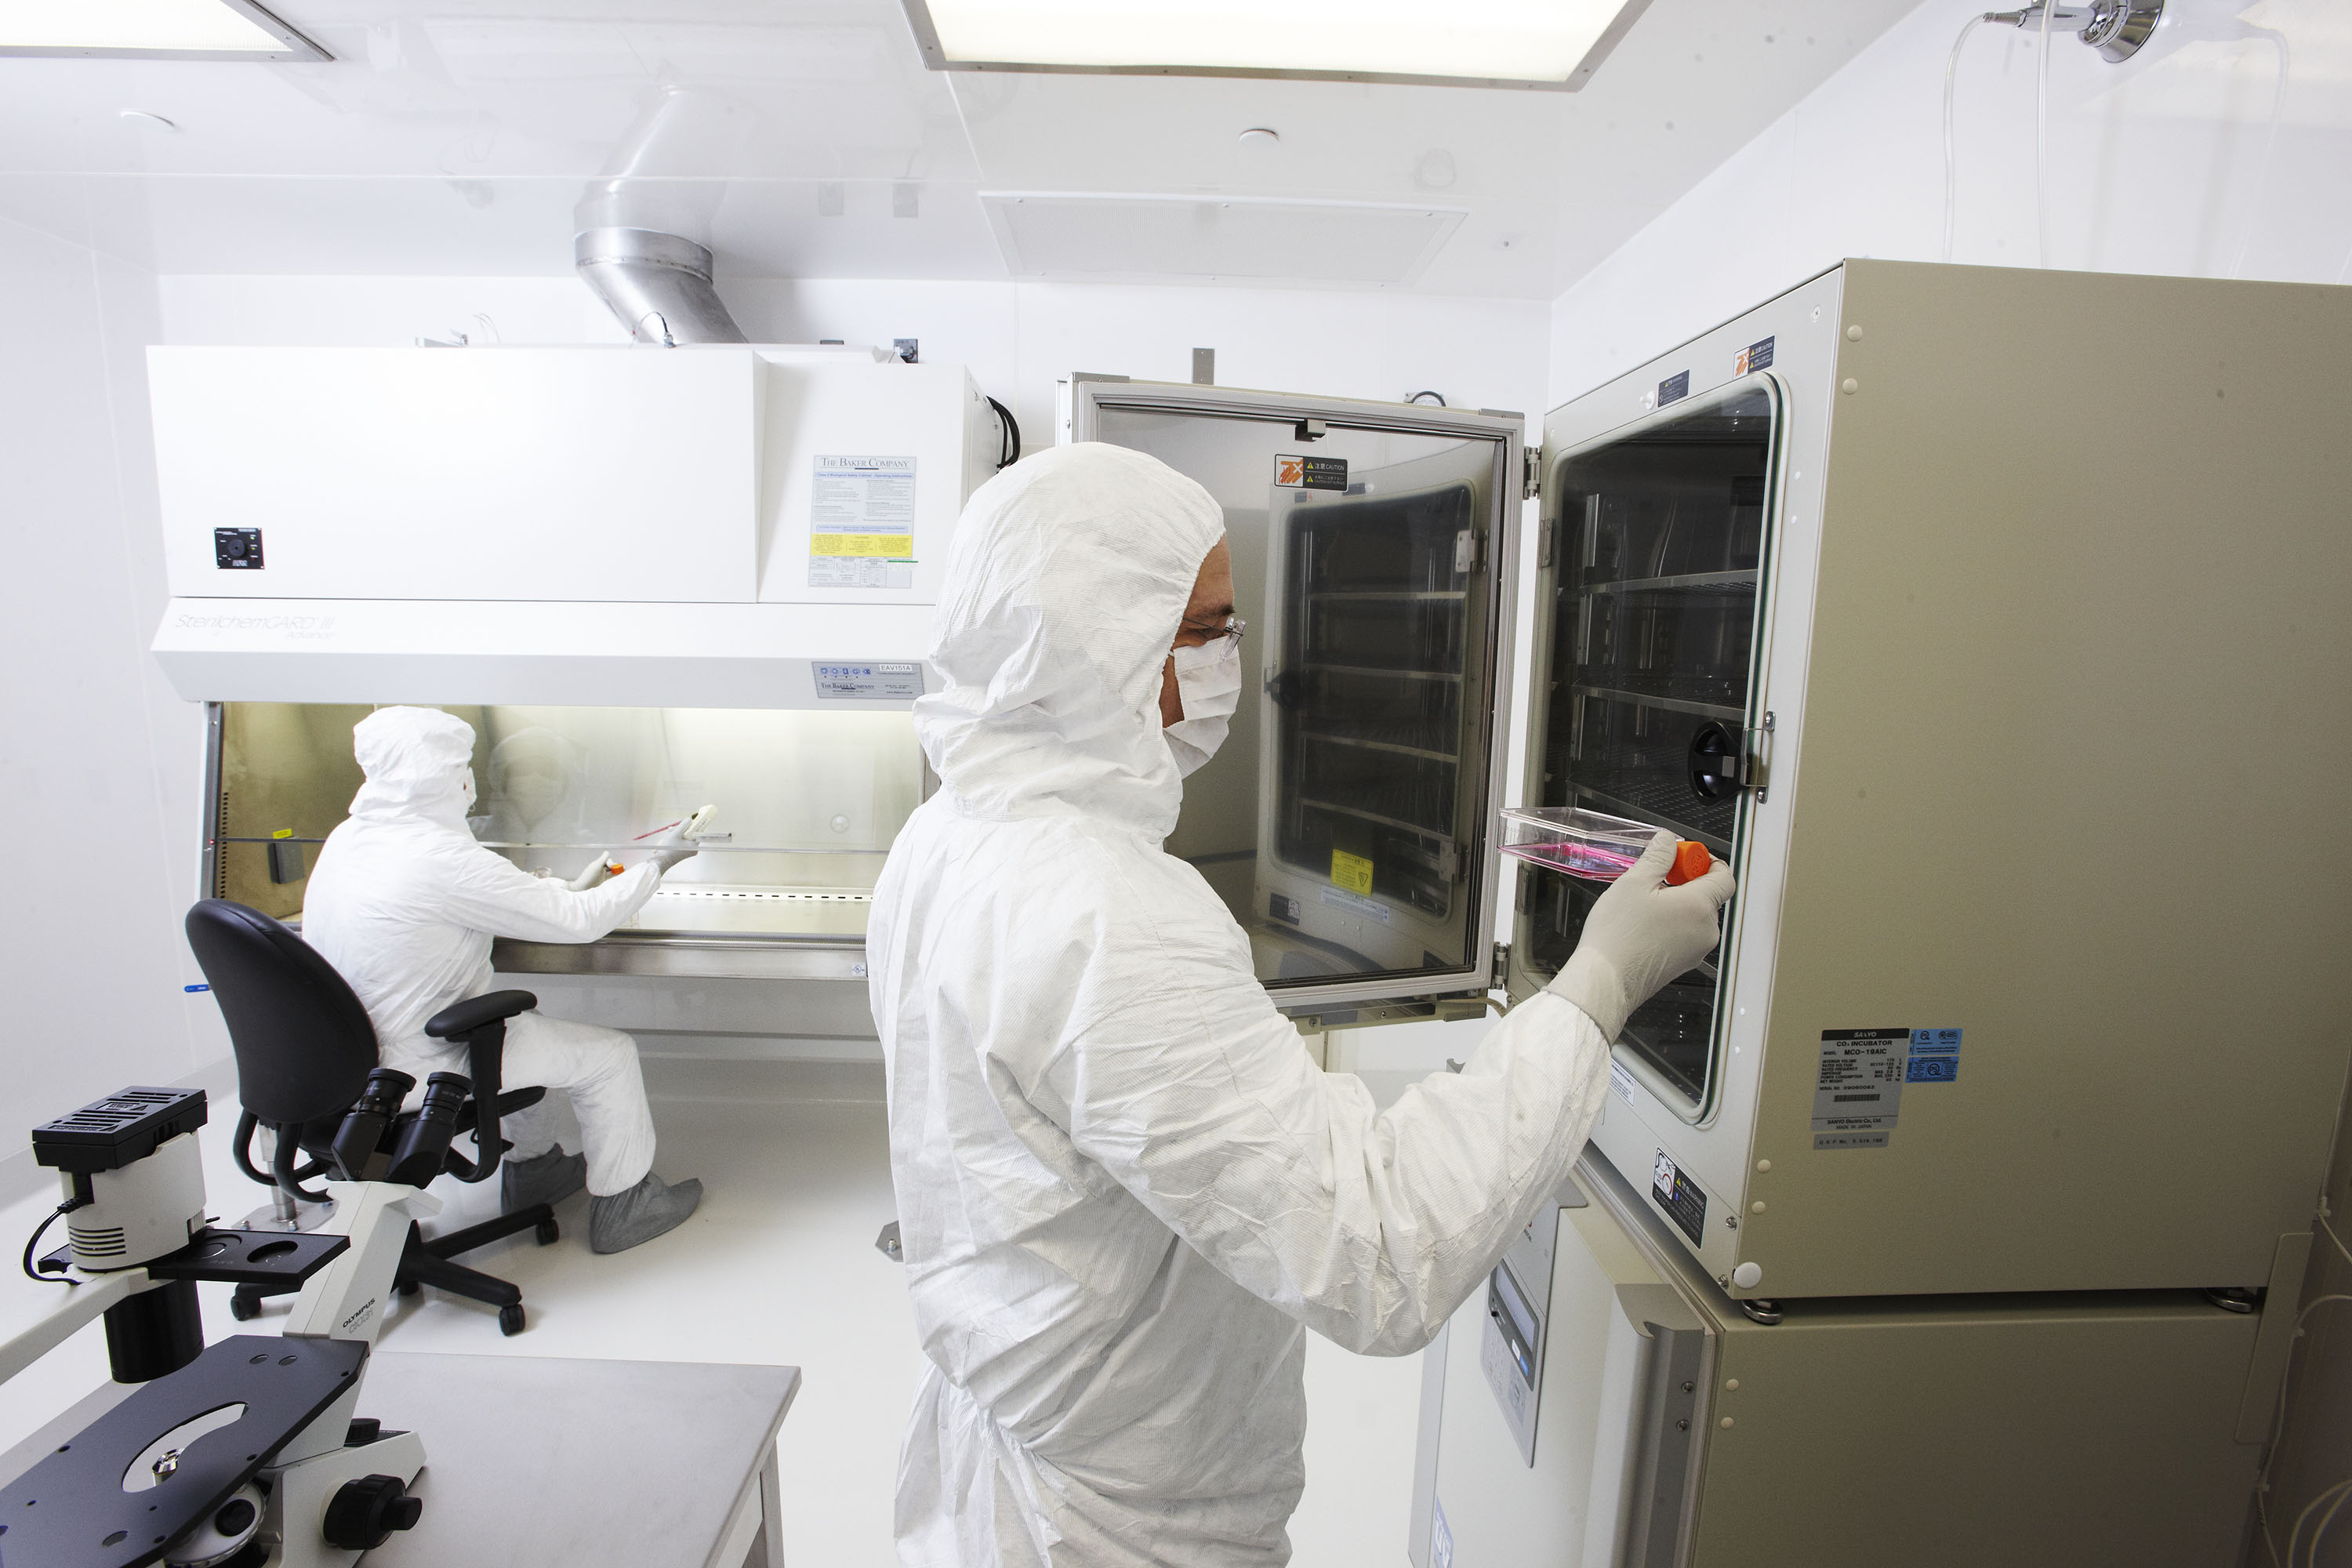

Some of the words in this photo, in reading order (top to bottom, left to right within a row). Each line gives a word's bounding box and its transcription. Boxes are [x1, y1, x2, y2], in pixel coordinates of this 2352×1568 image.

[822, 457, 838, 466] THE
[840, 457, 866, 467] BAKER
[869, 457, 909, 468] COMPANY
[343, 1298, 376, 1328] OLYMPUS
